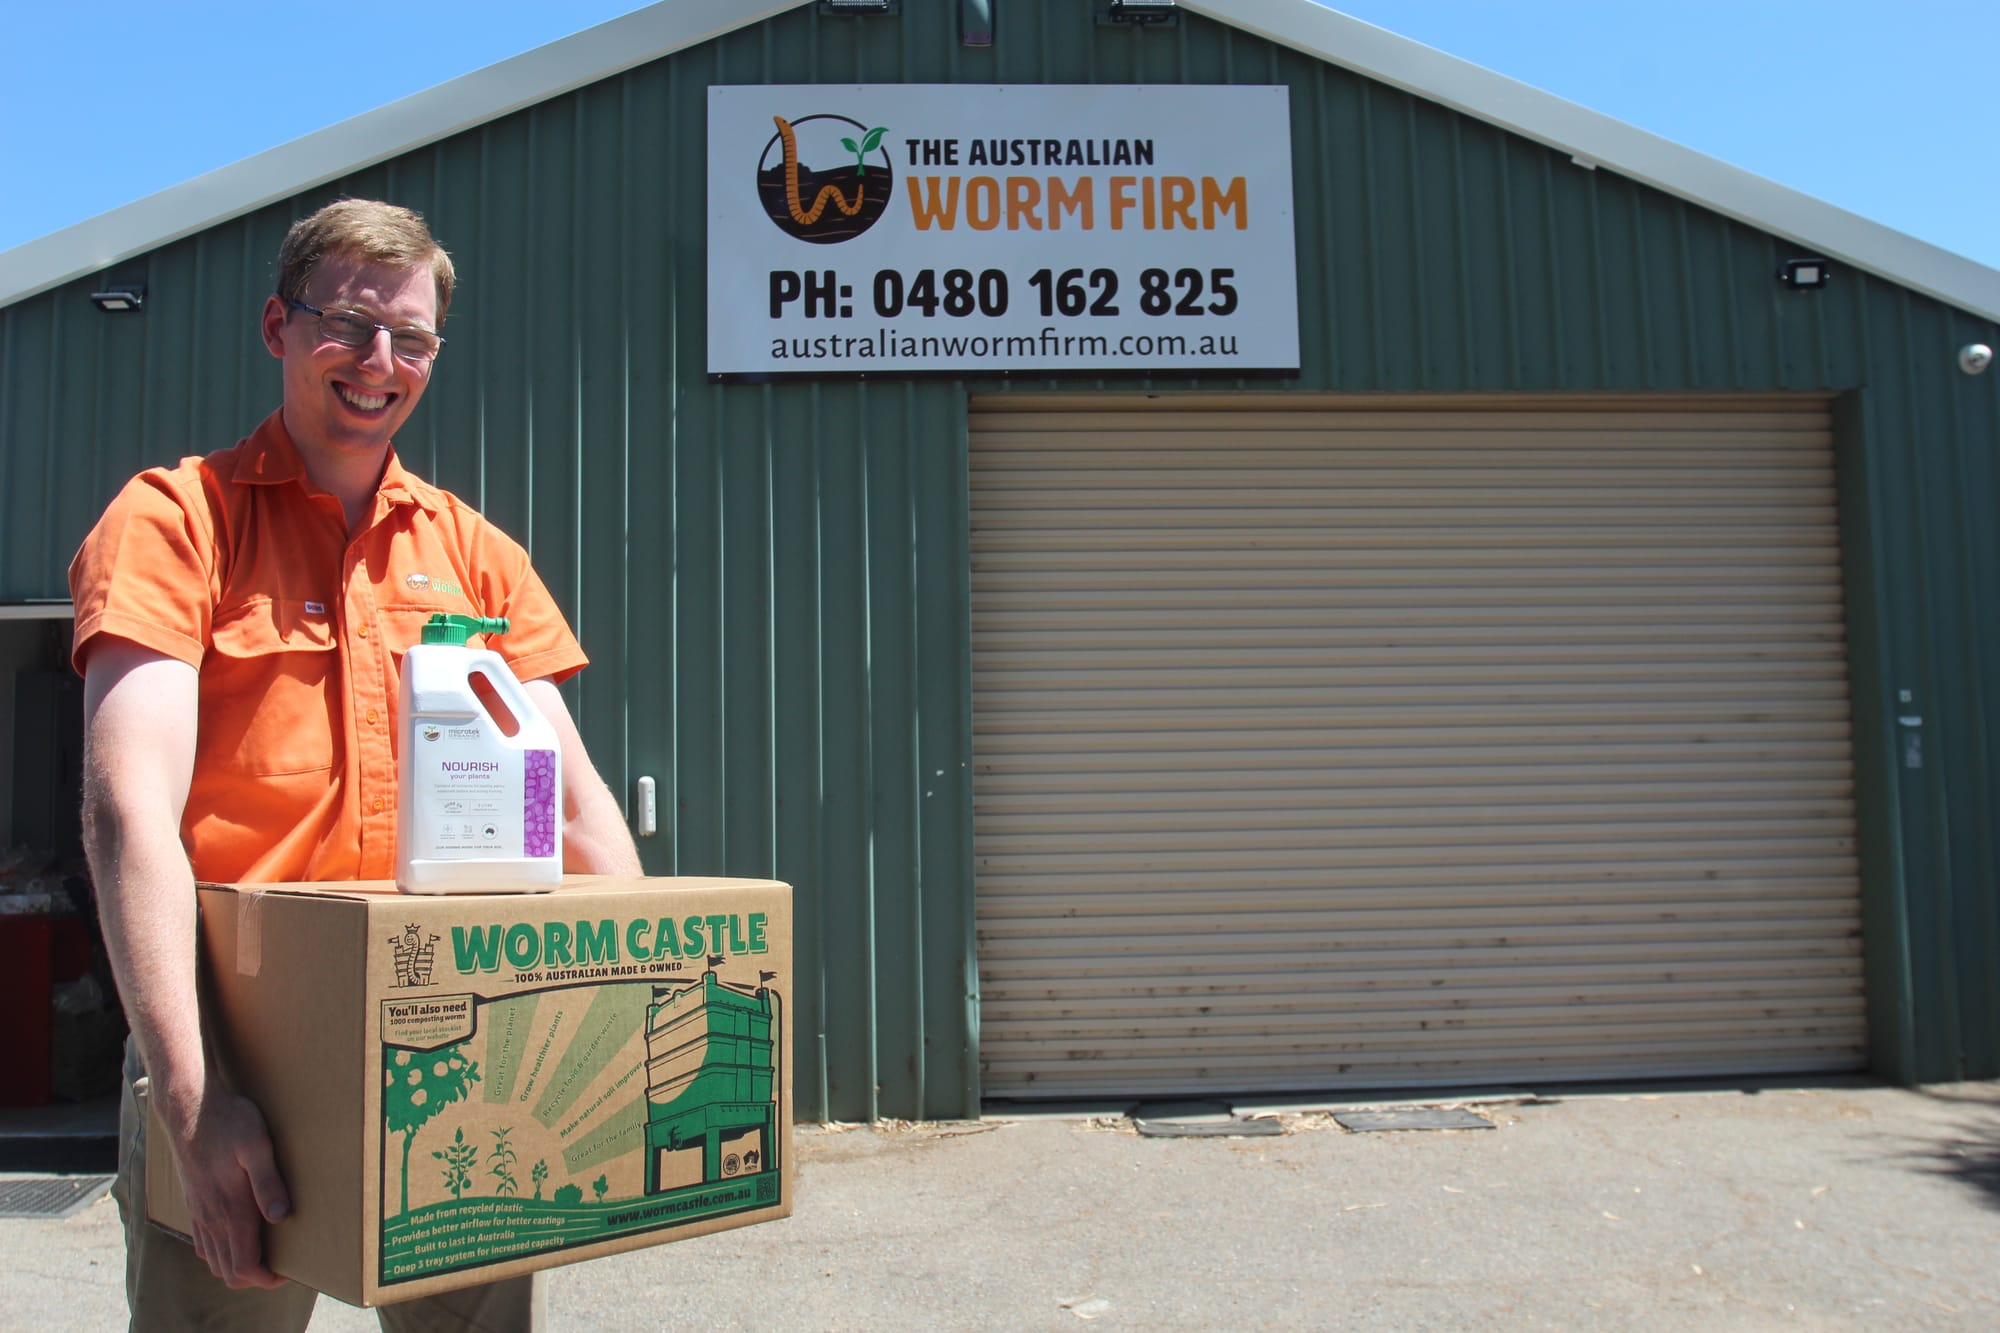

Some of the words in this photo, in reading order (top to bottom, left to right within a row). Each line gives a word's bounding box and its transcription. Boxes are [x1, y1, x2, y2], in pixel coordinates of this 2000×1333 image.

[906, 139, 959, 166] THE
[968, 139, 1154, 166] AUSTRALIAN
[906, 176, 1095, 231] WORM
[1110, 176, 1248, 231] FIRM
[769, 270, 853, 319] PH:
[873, 269, 1009, 318] 0480
[1028, 268, 1119, 317] 162
[1139, 268, 1239, 317] 825
[770, 327, 1239, 359] australianwormfirm.com.au
[442, 762, 498, 772] NOURISH
[451, 919, 619, 974] WORM
[626, 912, 768, 961] CASTLE
[515, 973, 542, 983] 100%
[546, 967, 608, 981] AUSTRALIAN
[611, 965, 638, 976] MADE
[641, 965, 646, 973] &
[650, 962, 682, 973] OWNED
[388, 1005, 418, 1017] You'll
[420, 1004, 440, 1014] also
[443, 1001, 466, 1012] need
[407, 1015, 443, 1024] composting
[495, 1072, 504, 1096] Great
[500, 1056, 508, 1069] for
[507, 1007, 516, 1036] planet
[520, 1079, 534, 1102] Grow
[530, 1038, 551, 1077] healthier
[550, 1011, 563, 1038] plants
[543, 1088, 566, 1116] Recycle
[564, 1070, 579, 1087] food
[583, 1036, 601, 1062] garden
[600, 1013, 617, 1035] waste
[560, 1120, 578, 1138] Make
[580, 1098, 603, 1120] natural
[615, 1061, 642, 1088] improver
[572, 1150, 592, 1162] Great
[593, 1142, 604, 1150] for
[606, 1135, 618, 1144] the
[619, 1122, 641, 1137] family
[410, 1214, 434, 1225] Made
[436, 1209, 457, 1220] from
[459, 1203, 494, 1215] recycled
[495, 1202, 523, 1213] plastic
[607, 1188, 750, 1226] www.wormcastle.com.au
[392, 1230, 430, 1246] Provides
[432, 1222, 458, 1235] better
[460, 1218, 492, 1230] airflow
[493, 1215, 505, 1227] for
[506, 1215, 531, 1226] better
[532, 1213, 565, 1225] castings
[415, 1242, 436, 1254] Built
[438, 1239, 447, 1248] to
[449, 1236, 466, 1246] last
[467, 1232, 475, 1243] in
[477, 1231, 515, 1242] Australia
[394, 1262, 416, 1274] Deep
[425, 1255, 443, 1268] tray
[444, 1250, 475, 1264] system
[477, 1246, 489, 1257] for
[491, 1241, 529, 1254] increased
[531, 1236, 565, 1248] capacity
